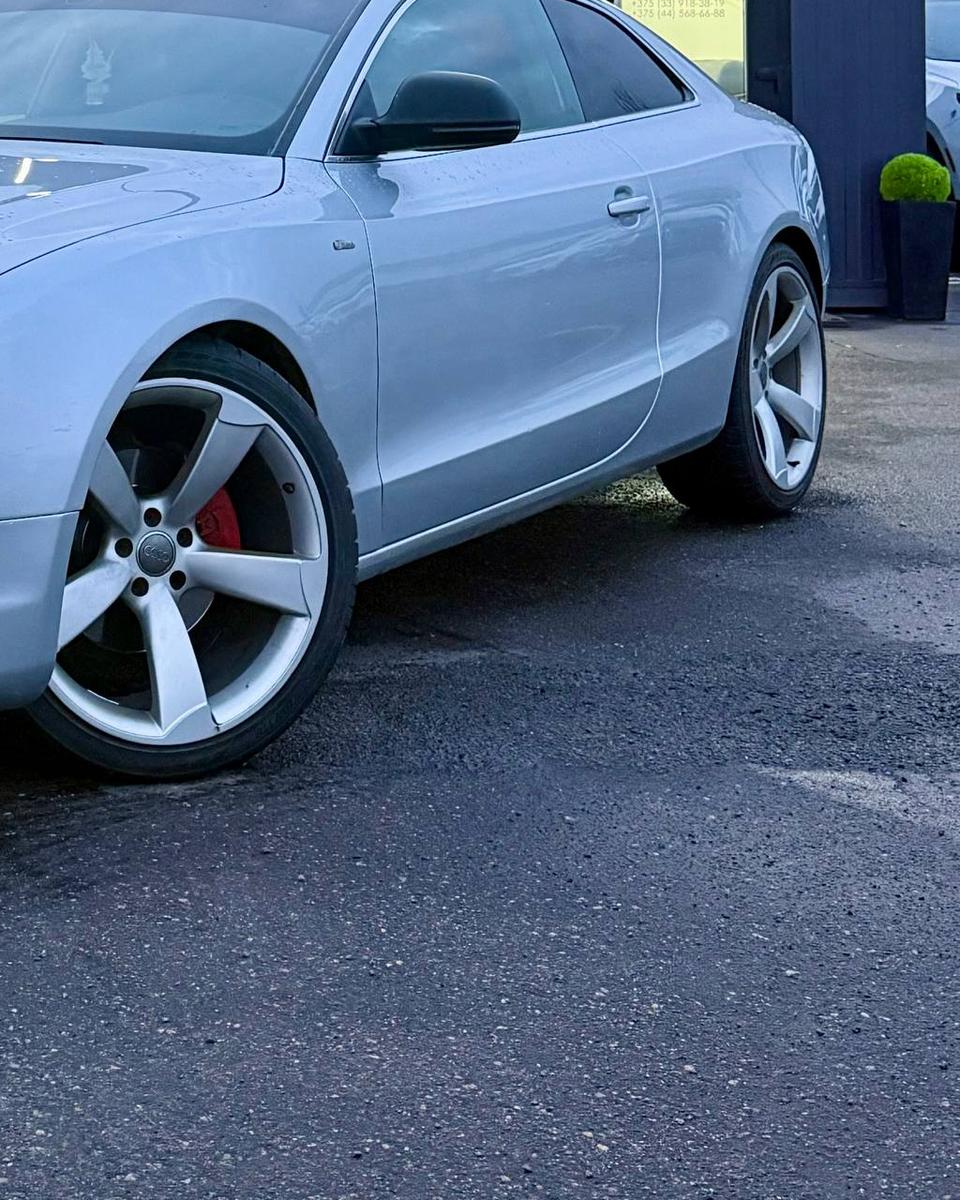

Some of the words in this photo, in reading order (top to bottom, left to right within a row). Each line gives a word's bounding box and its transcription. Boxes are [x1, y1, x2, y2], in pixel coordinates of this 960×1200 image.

[632, 0, 655, 8] +375
[657, 0, 675, 9] (33)
[678, 0, 725, 8] 918-38-19
[632, 9, 655, 18] +375
[657, 9, 676, 20] (44)
